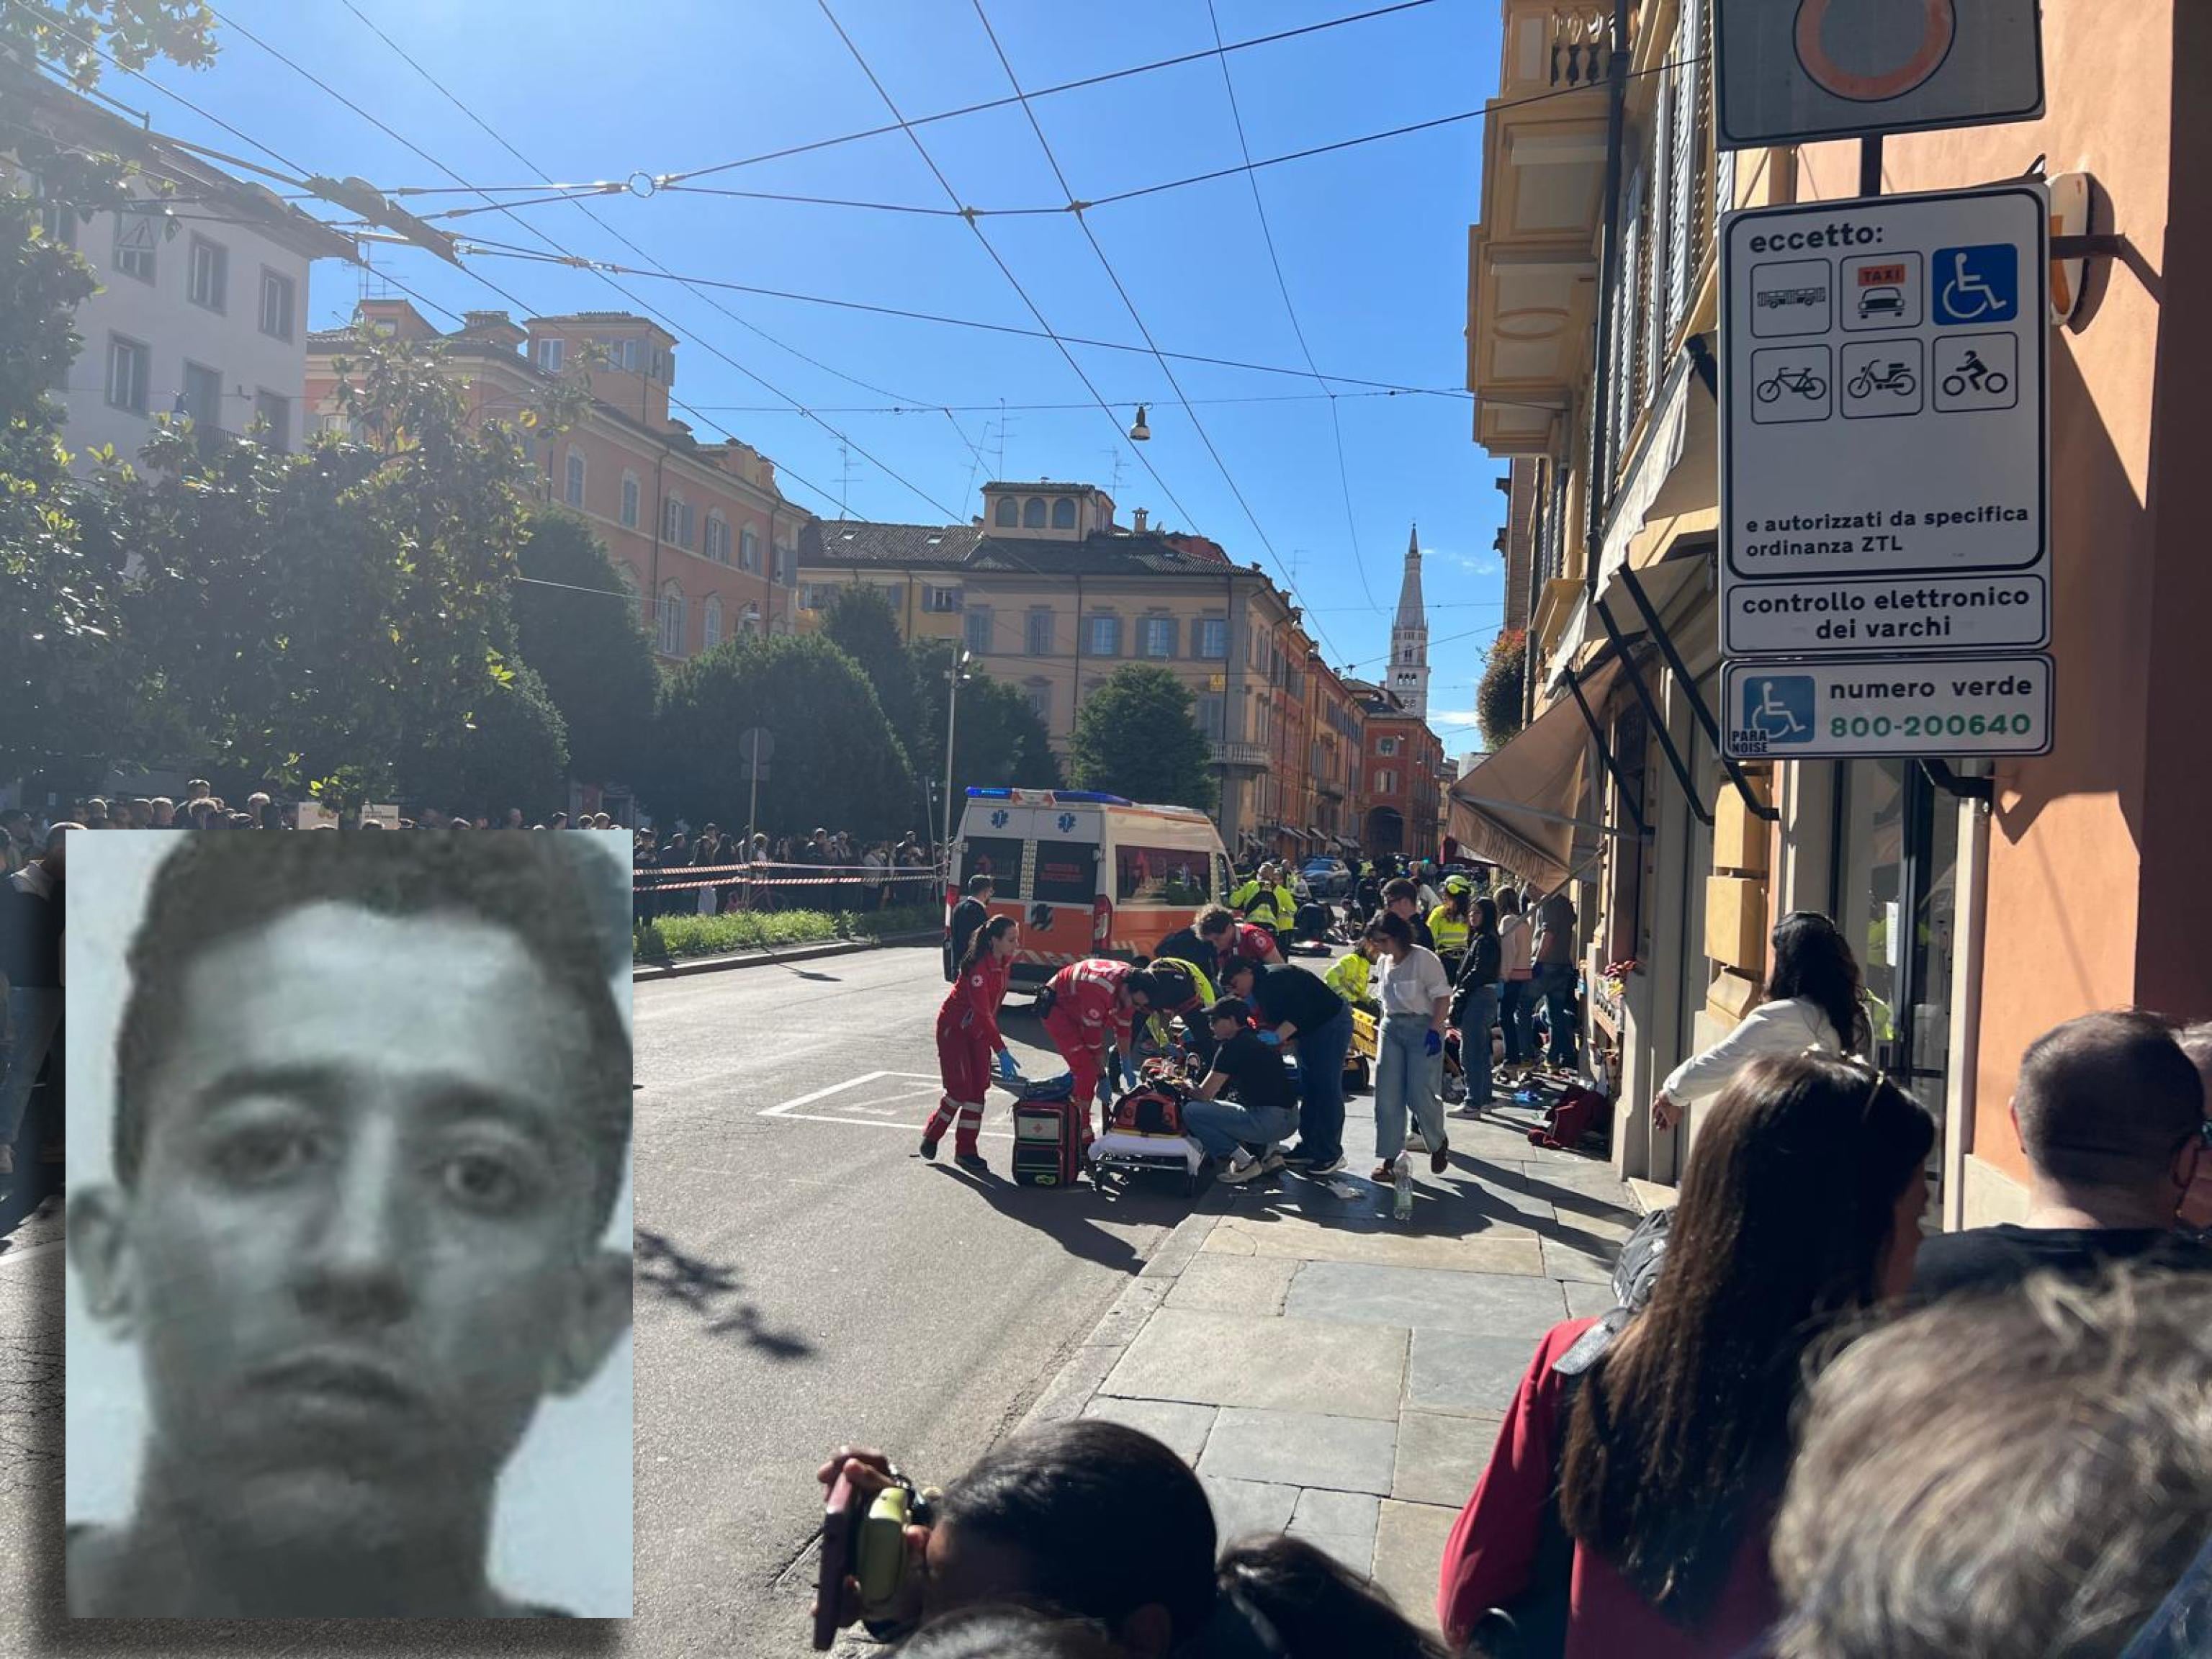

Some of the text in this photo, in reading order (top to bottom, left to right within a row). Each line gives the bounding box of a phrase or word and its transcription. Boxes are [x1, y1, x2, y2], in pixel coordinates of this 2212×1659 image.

[1750, 222, 1884, 253] eccetto:
[1863, 269, 1901, 283] TAXI
[1746, 505, 2028, 533] e autorizzati da specifica
[1745, 535, 1903, 557] ordinanza ZTL
[1743, 585, 2030, 614] controllo elettronico
[1816, 615, 1951, 639] dei varchi
[1830, 675, 2033, 699] numero verde
[1732, 730, 1768, 742] PARA
[1830, 713, 2031, 738] 800-200640
[1732, 742, 1768, 753] NOISE
